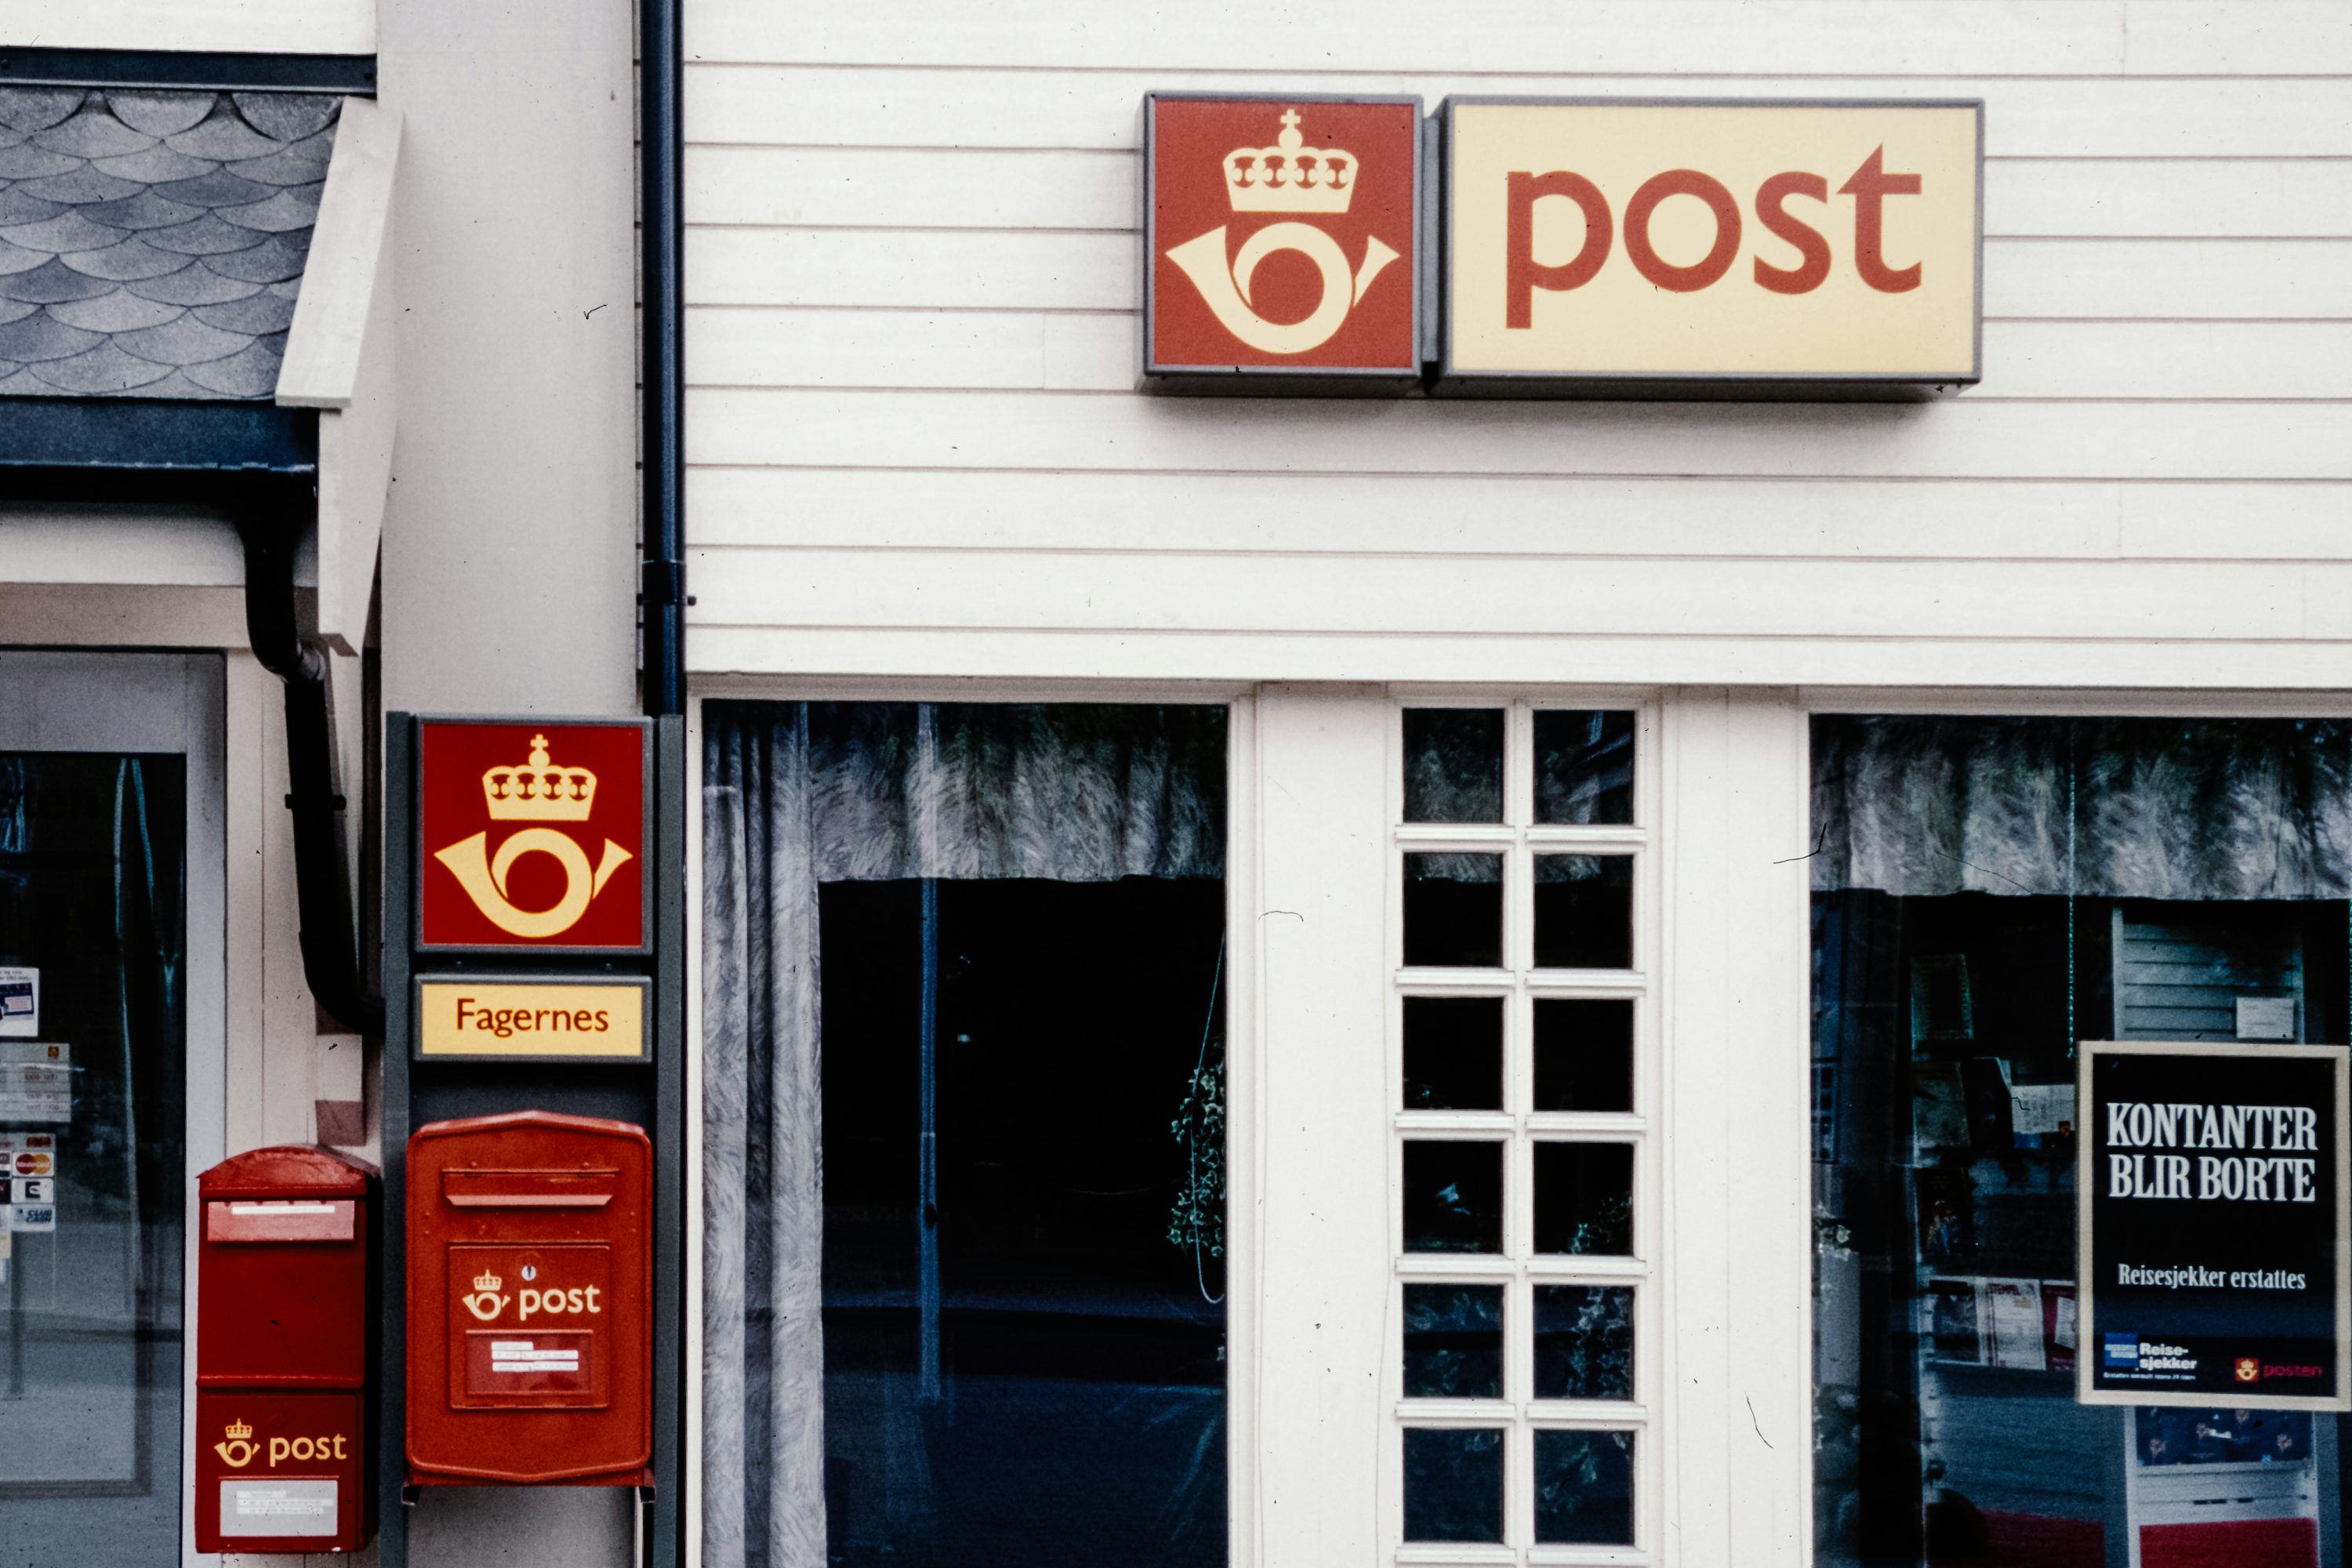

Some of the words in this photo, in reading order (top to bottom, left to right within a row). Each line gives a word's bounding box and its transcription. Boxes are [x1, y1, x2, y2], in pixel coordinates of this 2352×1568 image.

[1506, 143, 1922, 329] post
[457, 999, 608, 1036] Fagernes
[2107, 1102, 2318, 1150] KONTANTER
[2109, 1154, 2192, 1199] BLIR
[2198, 1156, 2315, 1202] BORTE
[2118, 1263, 2227, 1289] Reisesjekker
[2230, 1269, 2306, 1290] erstattes
[519, 1284, 601, 1321] post
[2140, 1342, 2189, 1356] Reise-
[2140, 1356, 2197, 1371] sjekker
[2263, 1364, 2322, 1378] posten
[269, 1433, 347, 1468] post
